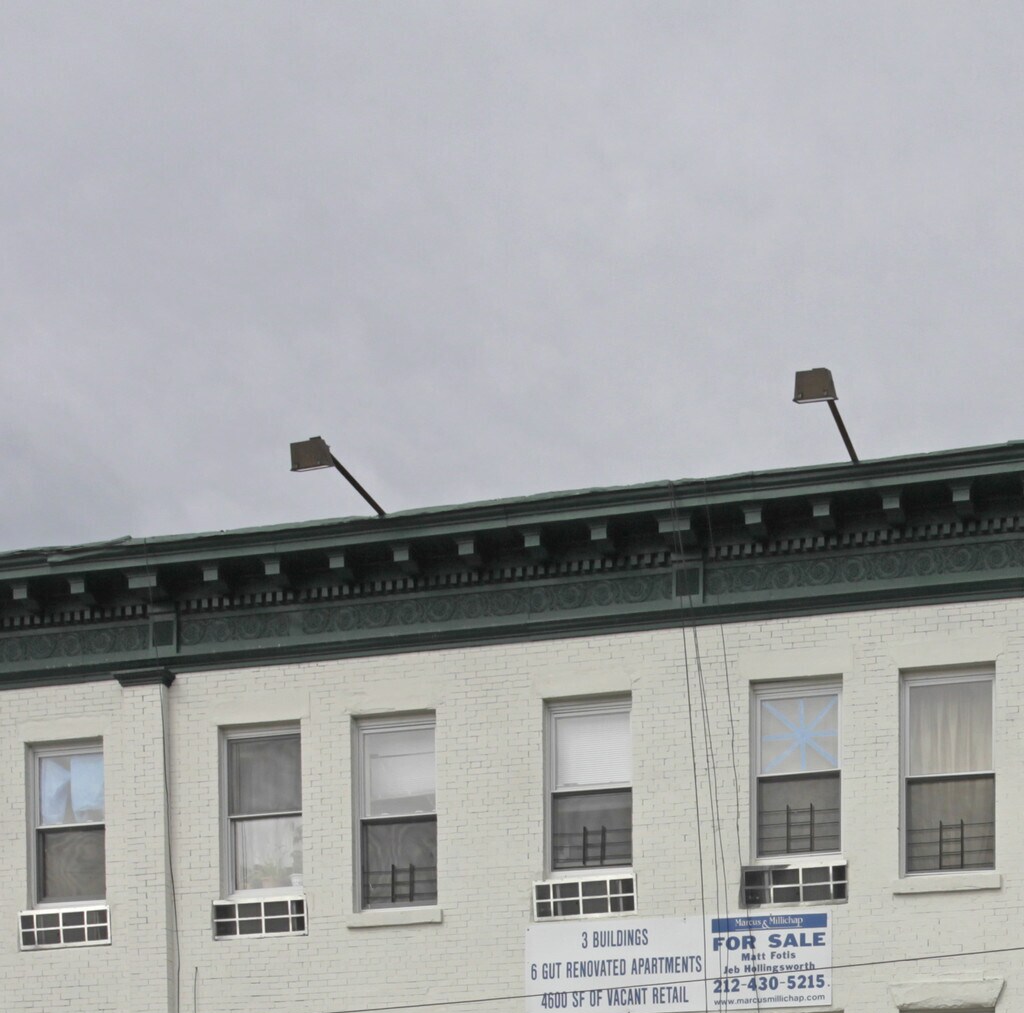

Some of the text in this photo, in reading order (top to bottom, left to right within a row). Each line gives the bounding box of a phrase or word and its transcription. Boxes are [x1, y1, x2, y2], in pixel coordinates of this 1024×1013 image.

[734, 915, 804, 929] Marcus & Millichap
[581, 929, 649, 949] 3 BUILDINGS
[712, 932, 826, 951] FOR SALE
[741, 950, 796, 962] Matt Fotis
[531, 955, 702, 981] 6 GUT RENOVATED APARTMENTS
[723, 960, 816, 975] Jeb Hollingsworth
[713, 974, 826, 994] 212-430-5215
[541, 986, 689, 1010] 4600 SF OF VACANT RETAIL
[714, 993, 826, 1006] www.marcusmillichap.com
